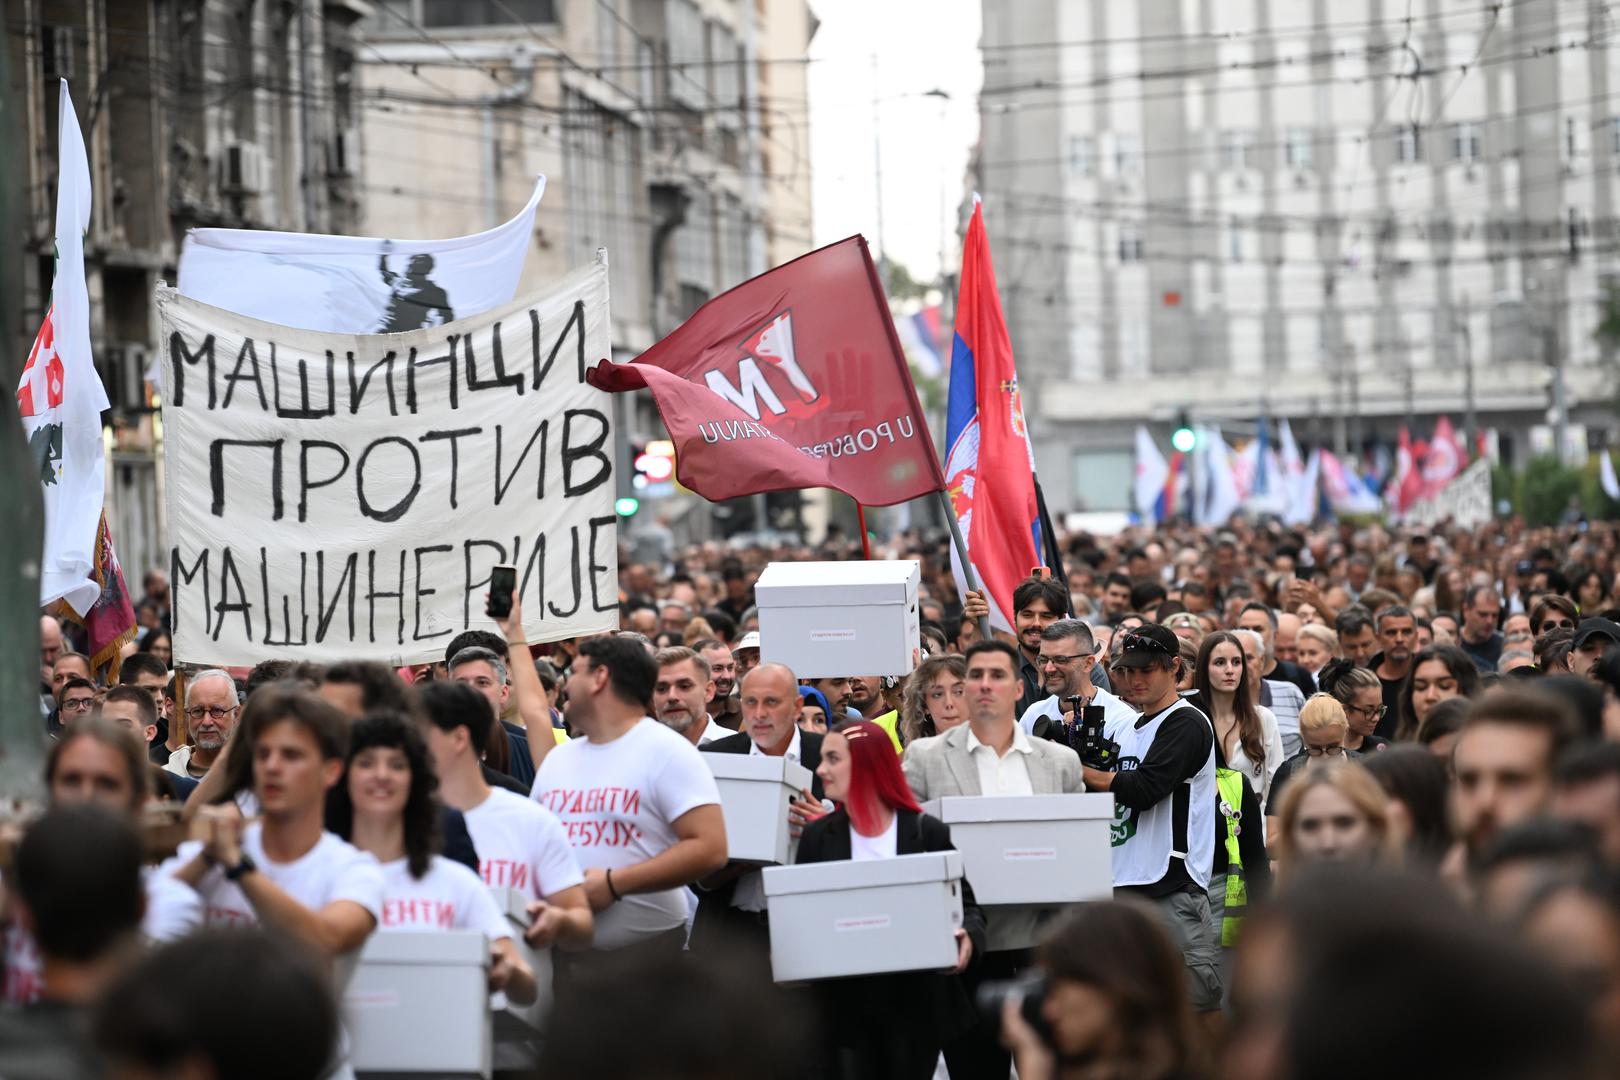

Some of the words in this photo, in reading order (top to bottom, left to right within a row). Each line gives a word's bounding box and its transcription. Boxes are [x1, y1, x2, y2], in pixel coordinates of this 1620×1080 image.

[170, 300, 587, 419] МАШИНЦИ
[210, 408, 613, 523] ПРОТИВ
[170, 515, 620, 646] МАШИНЕРИЈЕ
[382, 897, 456, 929] ЕНТИ
